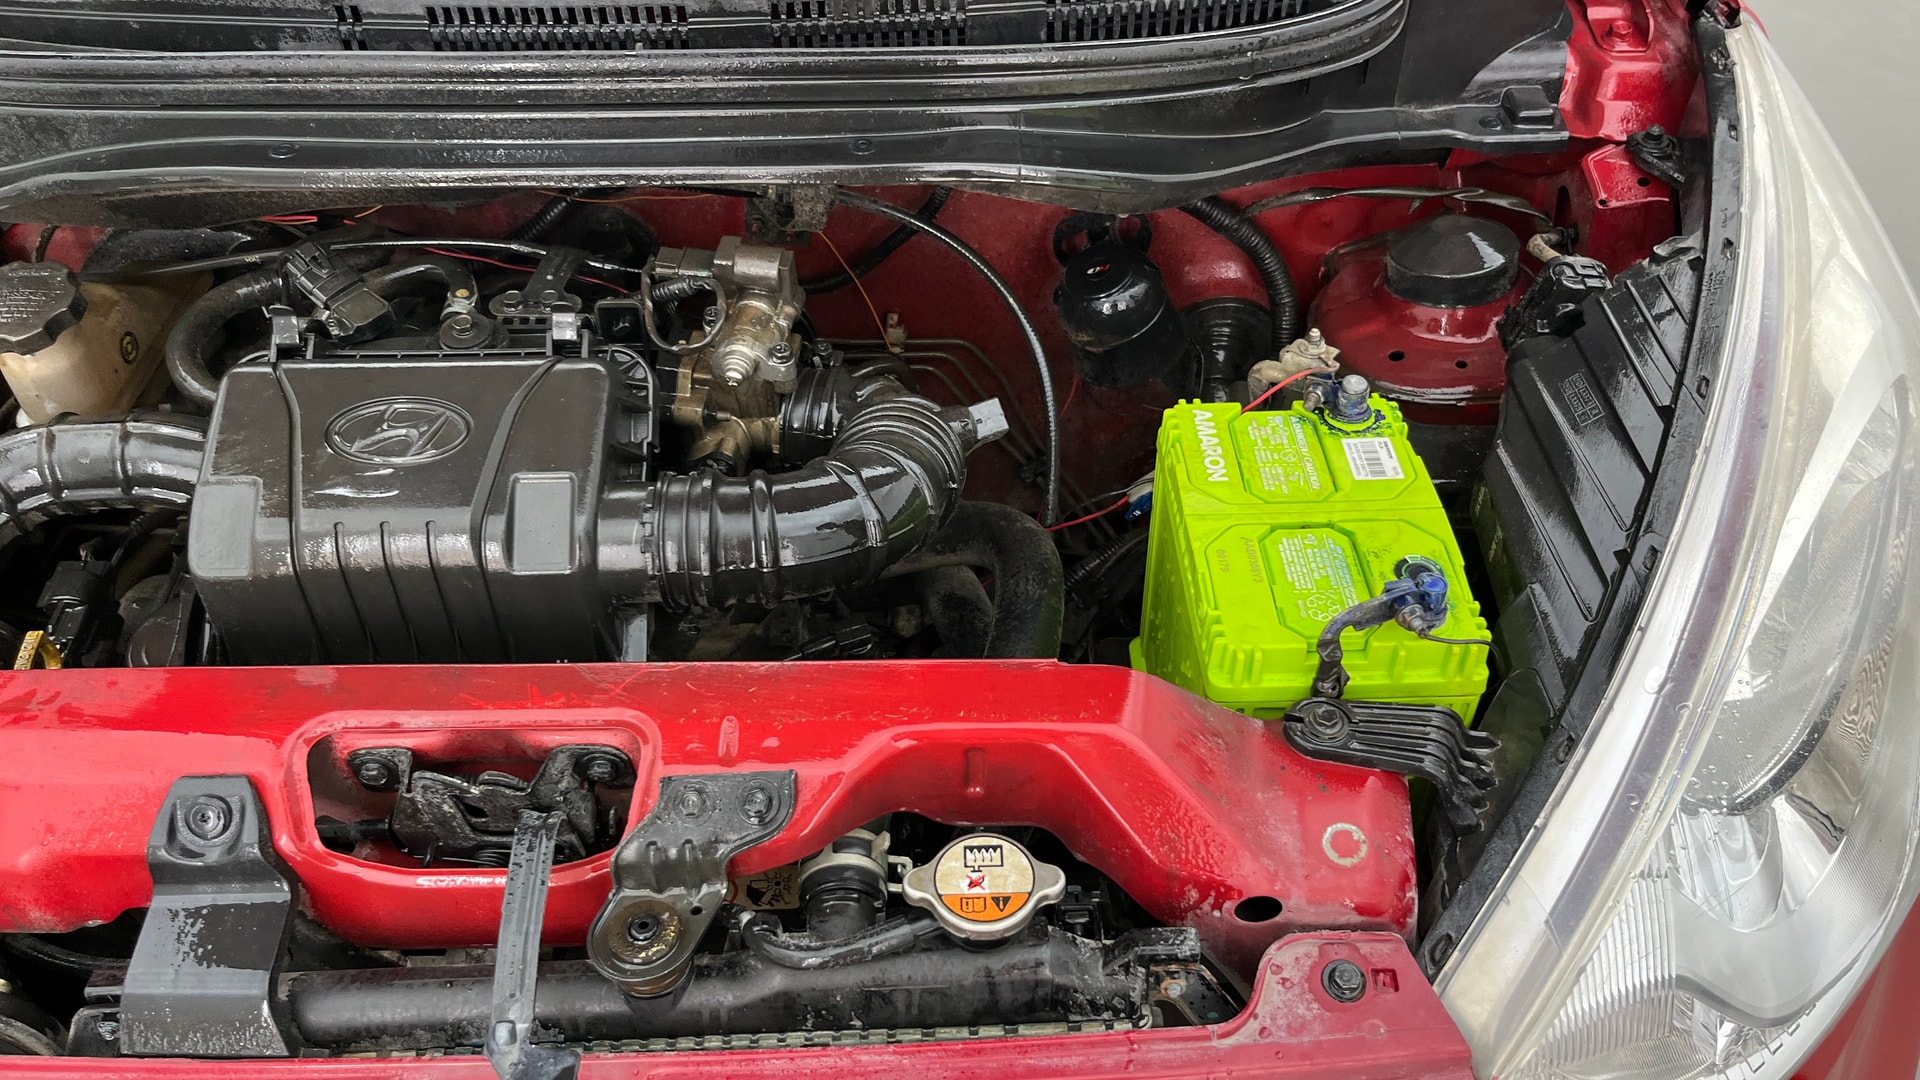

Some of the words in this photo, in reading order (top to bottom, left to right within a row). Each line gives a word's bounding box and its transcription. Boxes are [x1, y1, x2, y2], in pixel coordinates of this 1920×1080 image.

[1192, 409, 1229, 481] AMARON
[1293, 422, 1309, 452] DANGER
[1304, 457, 1321, 489] CAUTION
